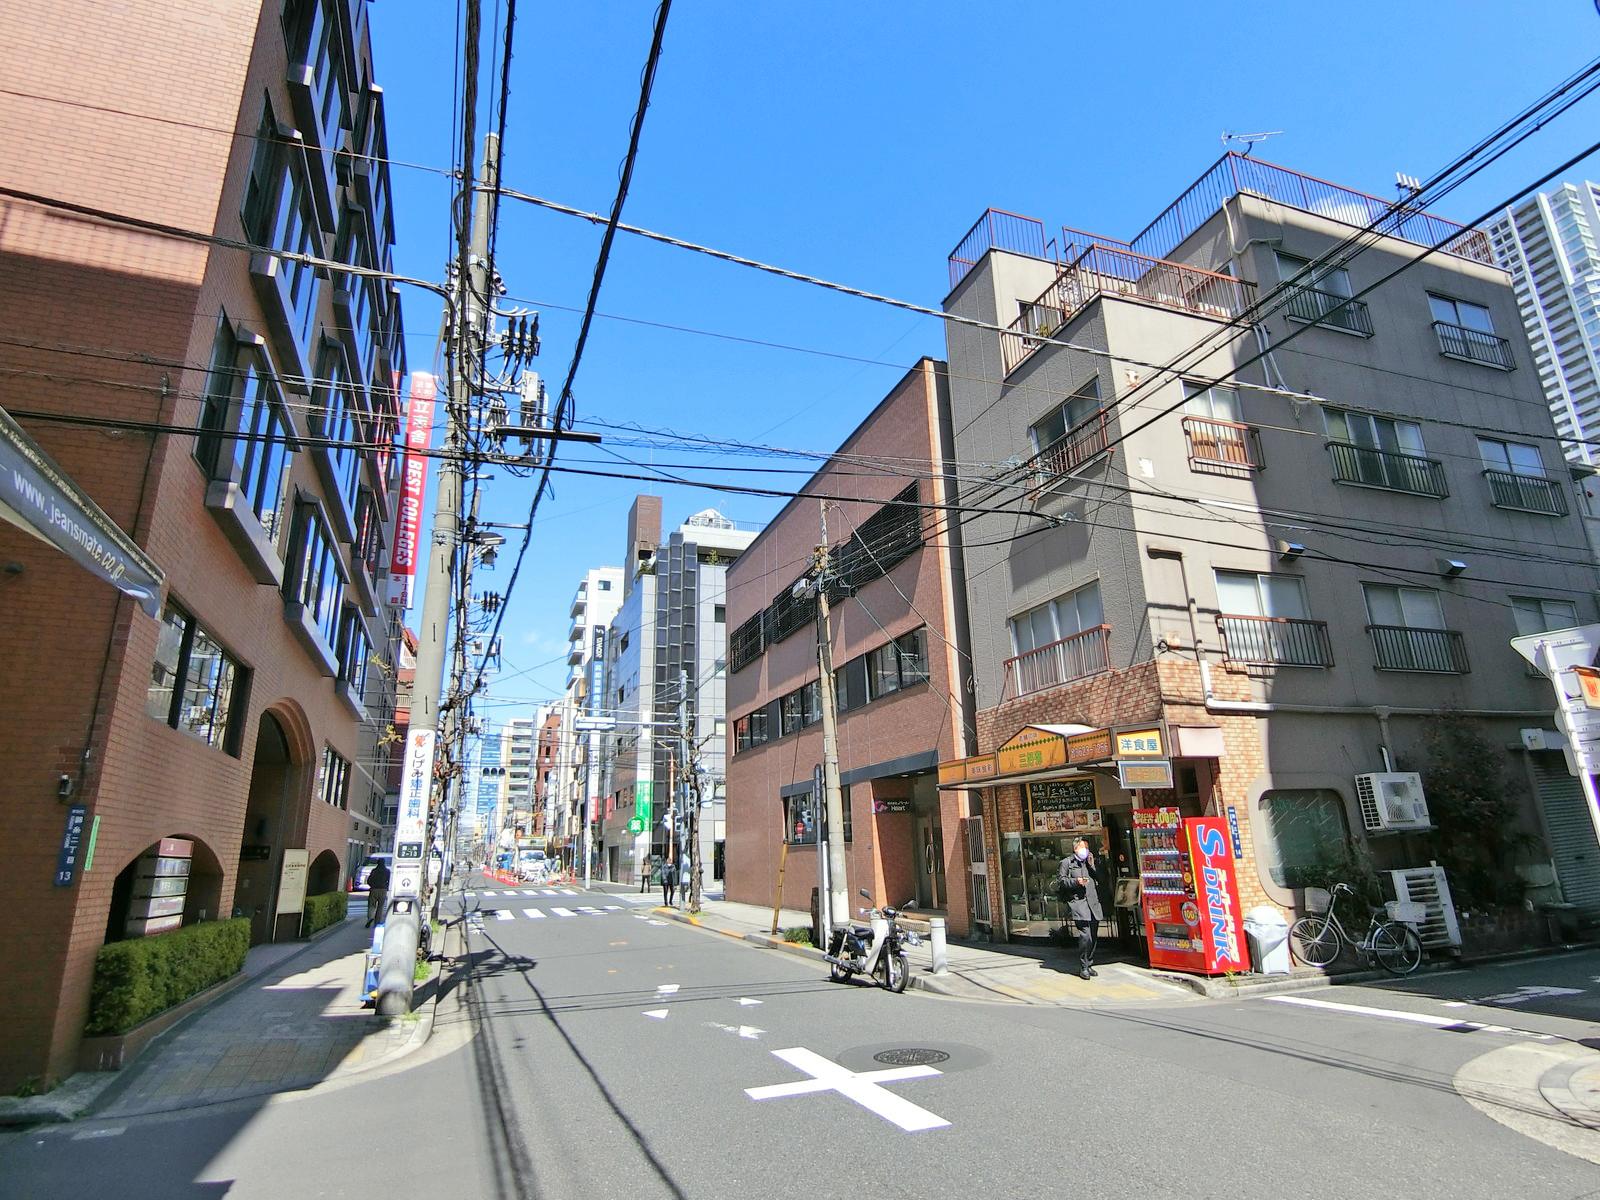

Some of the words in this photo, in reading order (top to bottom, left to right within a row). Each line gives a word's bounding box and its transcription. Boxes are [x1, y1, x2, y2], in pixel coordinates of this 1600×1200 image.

[405, 459, 423, 496] BEST
[395, 496, 419, 568] COLLEGES
[1120, 738, 1158, 751] 洋食屋
[407, 749, 425, 818] しげみ矯正歯科
[59, 871, 72, 881] 13
[1196, 824, 1232, 963] S-DRINK
